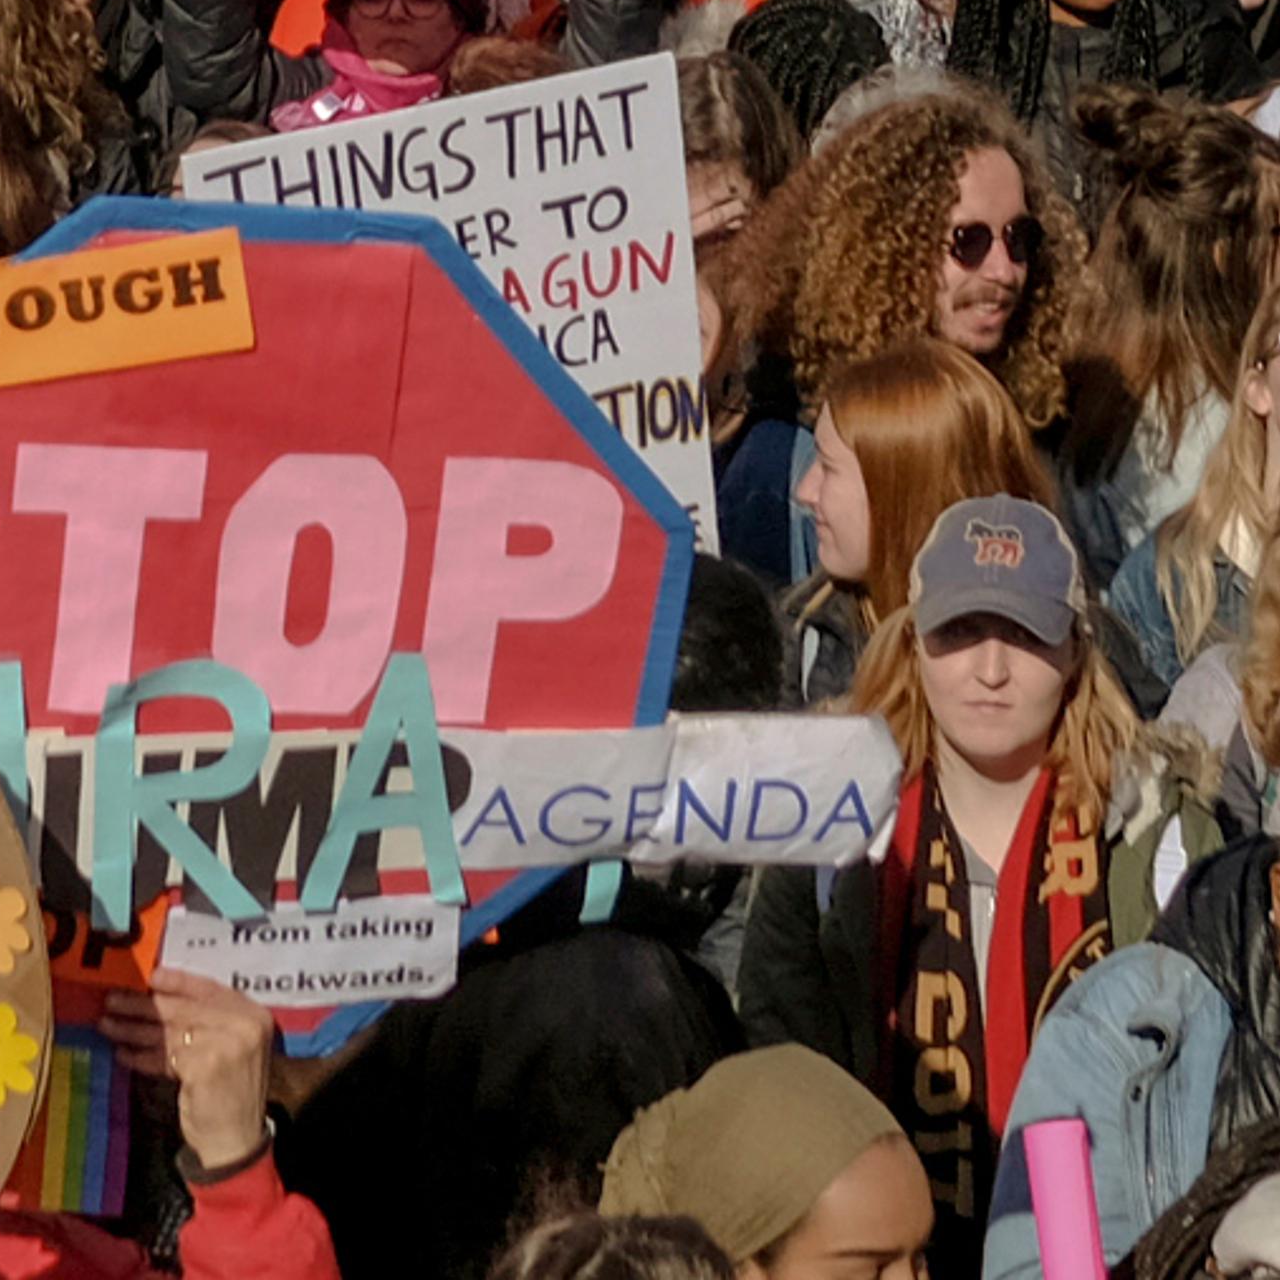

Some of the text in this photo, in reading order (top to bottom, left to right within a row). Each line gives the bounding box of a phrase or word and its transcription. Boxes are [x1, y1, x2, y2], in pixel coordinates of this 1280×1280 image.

[204, 84, 648, 207] THINGS THAT
[463, 777, 876, 844] AGENDA
[231, 913, 436, 946] from taking
[231, 964, 436, 992] backwards.
